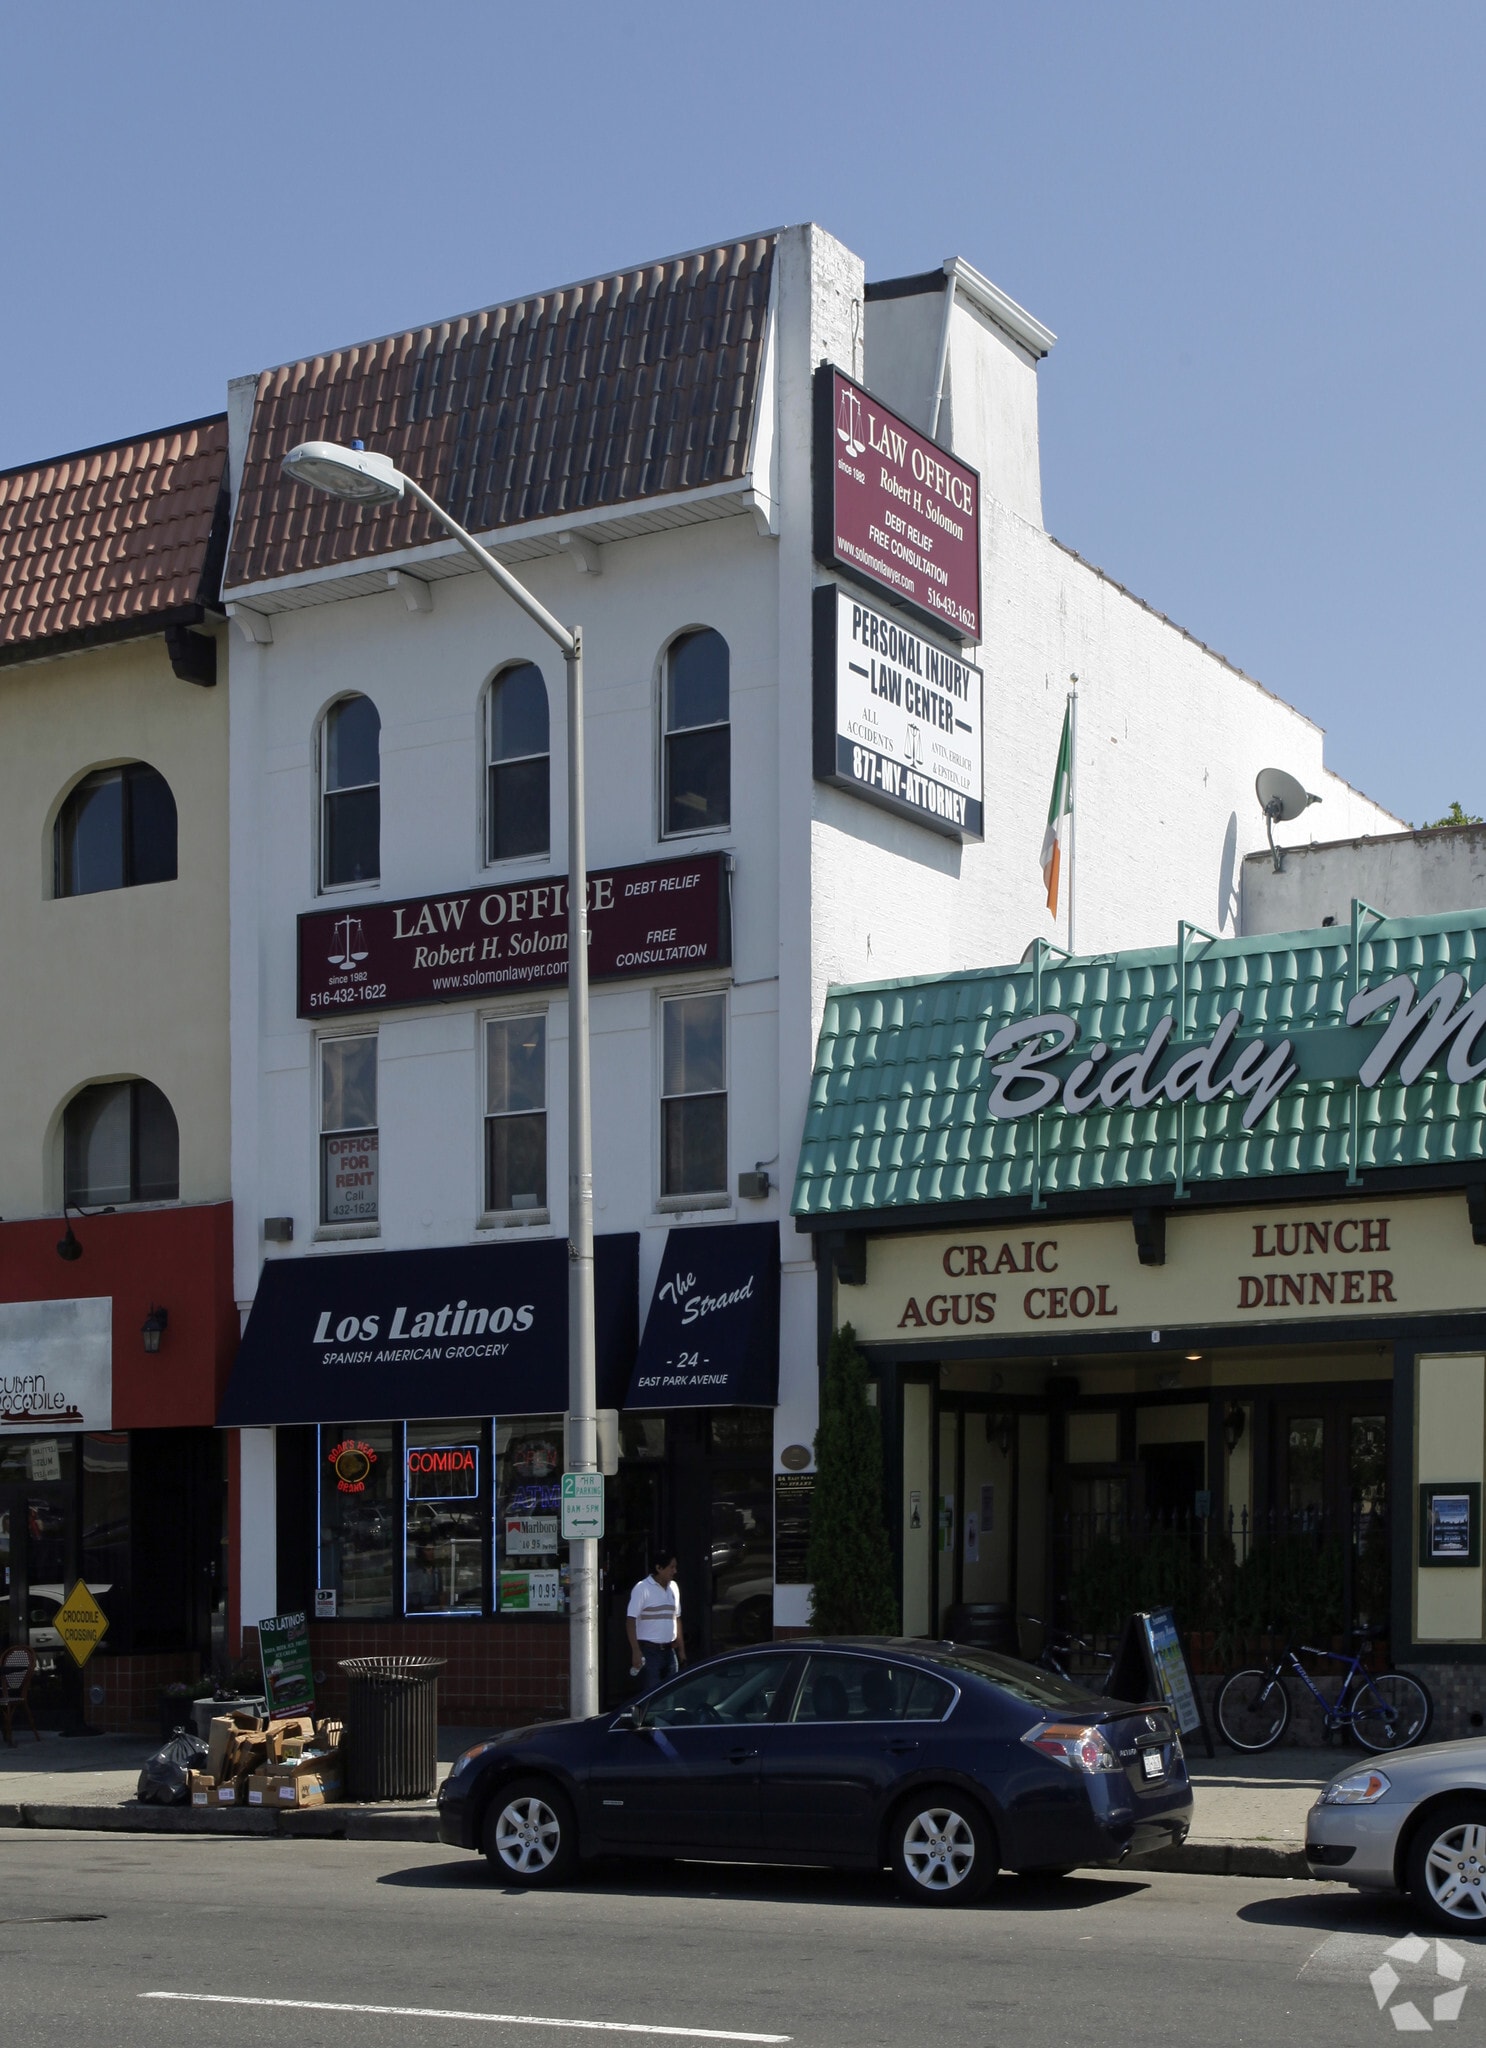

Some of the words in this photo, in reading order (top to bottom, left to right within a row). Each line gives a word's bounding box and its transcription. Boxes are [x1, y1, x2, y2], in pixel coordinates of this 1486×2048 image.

[837, 459, 852, 477] since
[853, 467, 866, 485] 1982
[867, 413, 908, 468] LAW
[911, 448, 973, 517] OFFICE
[880, 467, 911, 506] Robert
[913, 491, 924, 515] H.
[925, 502, 963, 542] Solomon
[885, 510, 906, 535] DEBT
[907, 523, 934, 552] RELIEF
[837, 536, 915, 593] www.solomonlawyer.com
[869, 524, 889, 550] FREE
[890, 538, 948, 587] CONSULTATION
[927, 587, 976, 630] 516-432-1622
[852, 603, 922, 675] PERSONAL
[925, 644, 970, 702] INJURY
[870, 658, 902, 707] LAW
[905, 677, 953, 735] CENTER
[862, 706, 879, 726] ALL
[847, 719, 894, 752] ACCIDENTS
[853, 745, 967, 826] 877-MY-ATTORNEY
[393, 899, 470, 940] LAW
[480, 877, 615, 927] OFFIE
[625, 880, 657, 897] DEBT
[659, 874, 701, 892] RELIEF
[412, 937, 475, 970] Robert
[480, 936, 503, 960] H.
[508, 928, 593, 955] Solomn
[646, 928, 677, 944] FREE
[616, 943, 707, 967] CONSULTATION
[328, 973, 349, 986] since
[350, 971, 368, 984] 1982
[432, 960, 570, 991] www.solomonlawyer.com
[310, 984, 387, 1007] 516-432-1622
[983, 1007, 1299, 1130] Biddy
[329, 1136, 378, 1155] OFFICE
[340, 1155, 369, 1171] FOR
[335, 1171, 375, 1188] RENT
[333, 1202, 377, 1216] 432-1622
[345, 1190, 364, 1202] Call
[1252, 1218, 1391, 1258] LUNCH
[942, 1240, 1059, 1279] CRAIC
[658, 1272, 697, 1305] The
[681, 1275, 754, 1325] Strand
[1236, 1269, 1398, 1309] DINNER
[897, 1291, 997, 1329] AGUS
[1022, 1284, 1118, 1321] CEOL
[312, 1311, 381, 1344] Los
[388, 1300, 535, 1340] Latinos
[322, 1351, 373, 1365] SPANISH
[374, 1348, 442, 1363] AMERICAN
[445, 1343, 509, 1360] GROCERY
[638, 1376, 661, 1387] EAST
[662, 1375, 687, 1386] PARK
[689, 1374, 729, 1385] AVENUE
[408, 1450, 475, 1473] COMIDA
[337, 1479, 365, 1493] BRAND
[512, 1484, 561, 1509] ATM
[565, 1478, 574, 1494] 2
[583, 1476, 595, 1485] HR
[576, 1487, 601, 1495] PARKING
[521, 1521, 557, 1534] Marlboro
[62, 1610, 99, 1623] CROCODILE
[260, 1619, 275, 1632] LOS
[276, 1611, 305, 1631] LATINOS
[65, 1628, 97, 1641] CROSSING
